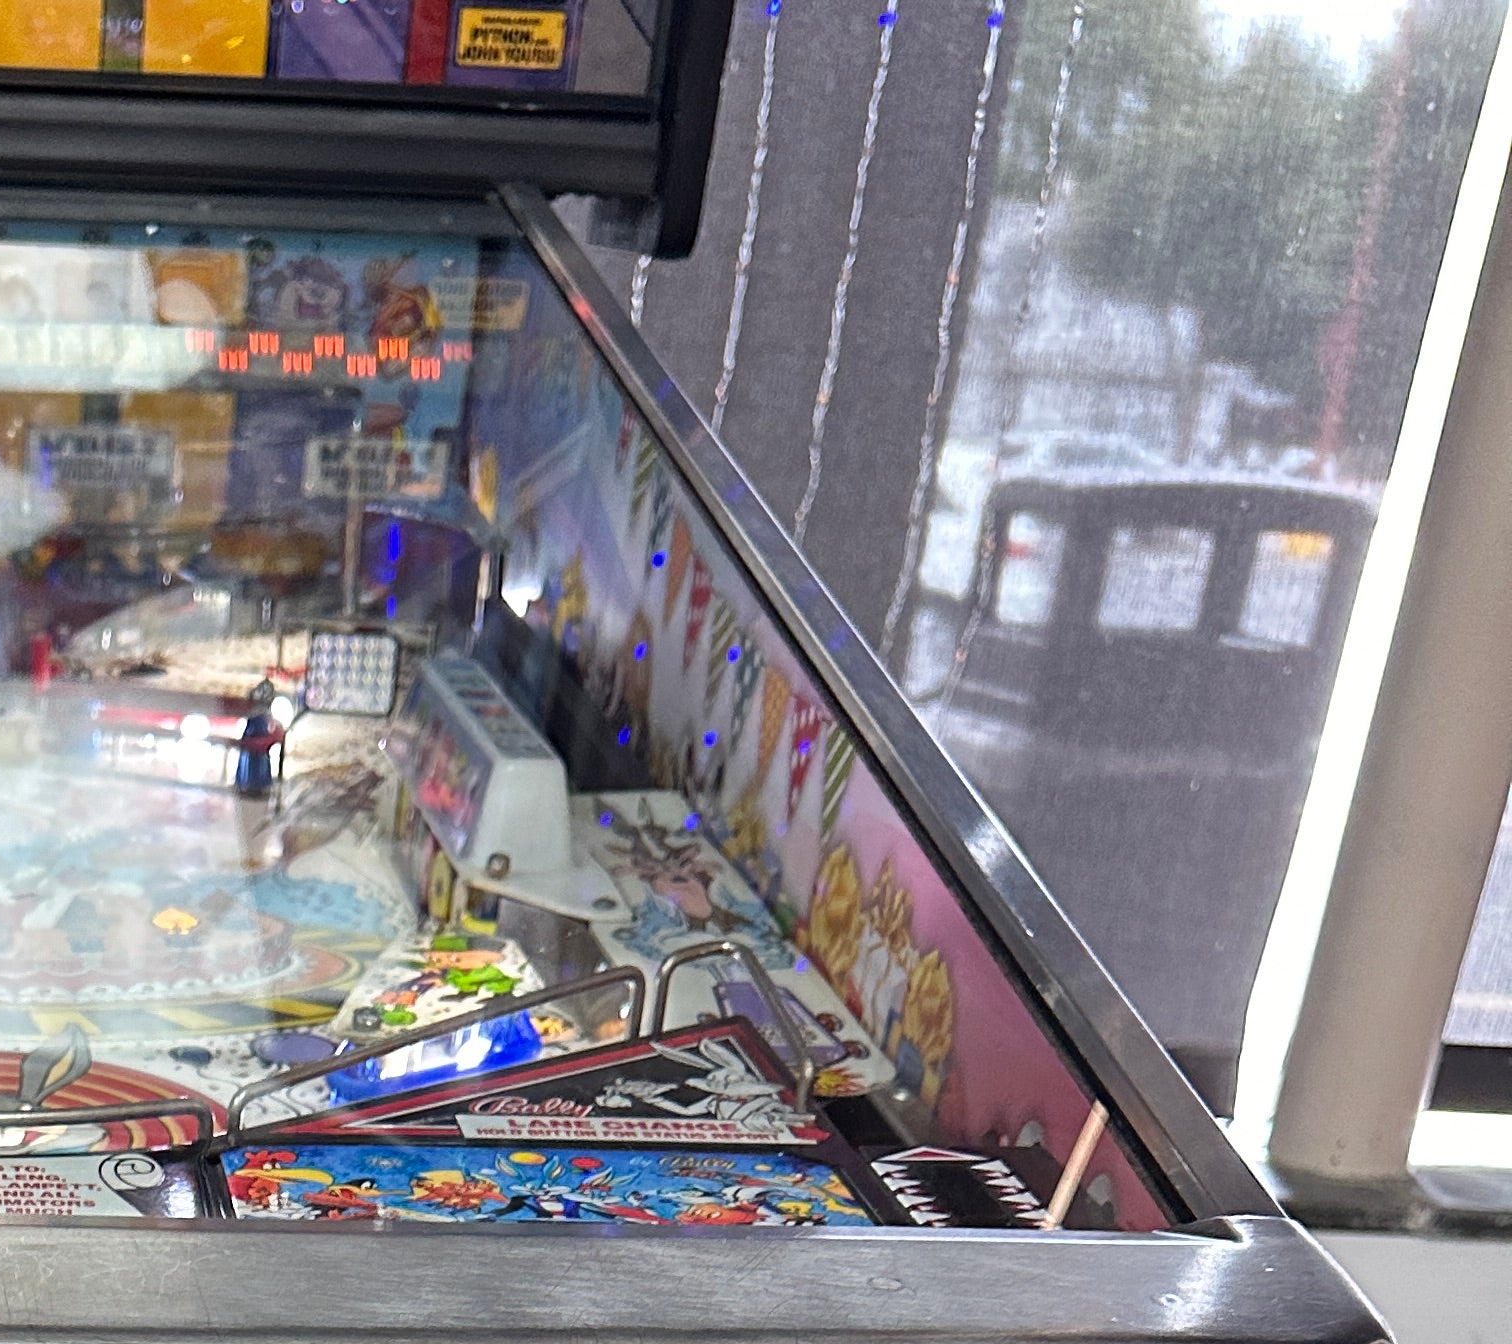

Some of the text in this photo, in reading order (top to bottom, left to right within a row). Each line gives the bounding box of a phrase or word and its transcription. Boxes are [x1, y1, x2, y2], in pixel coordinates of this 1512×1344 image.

[468, 1096, 595, 1117] Bally
[508, 1119, 739, 1132] LANE CHANGE
[476, 1128, 780, 1142] HOLD BUTTON FOR STATUS REPORT
[40, 1191, 81, 1199] ALL
[5, 1208, 74, 1216] MUCH
